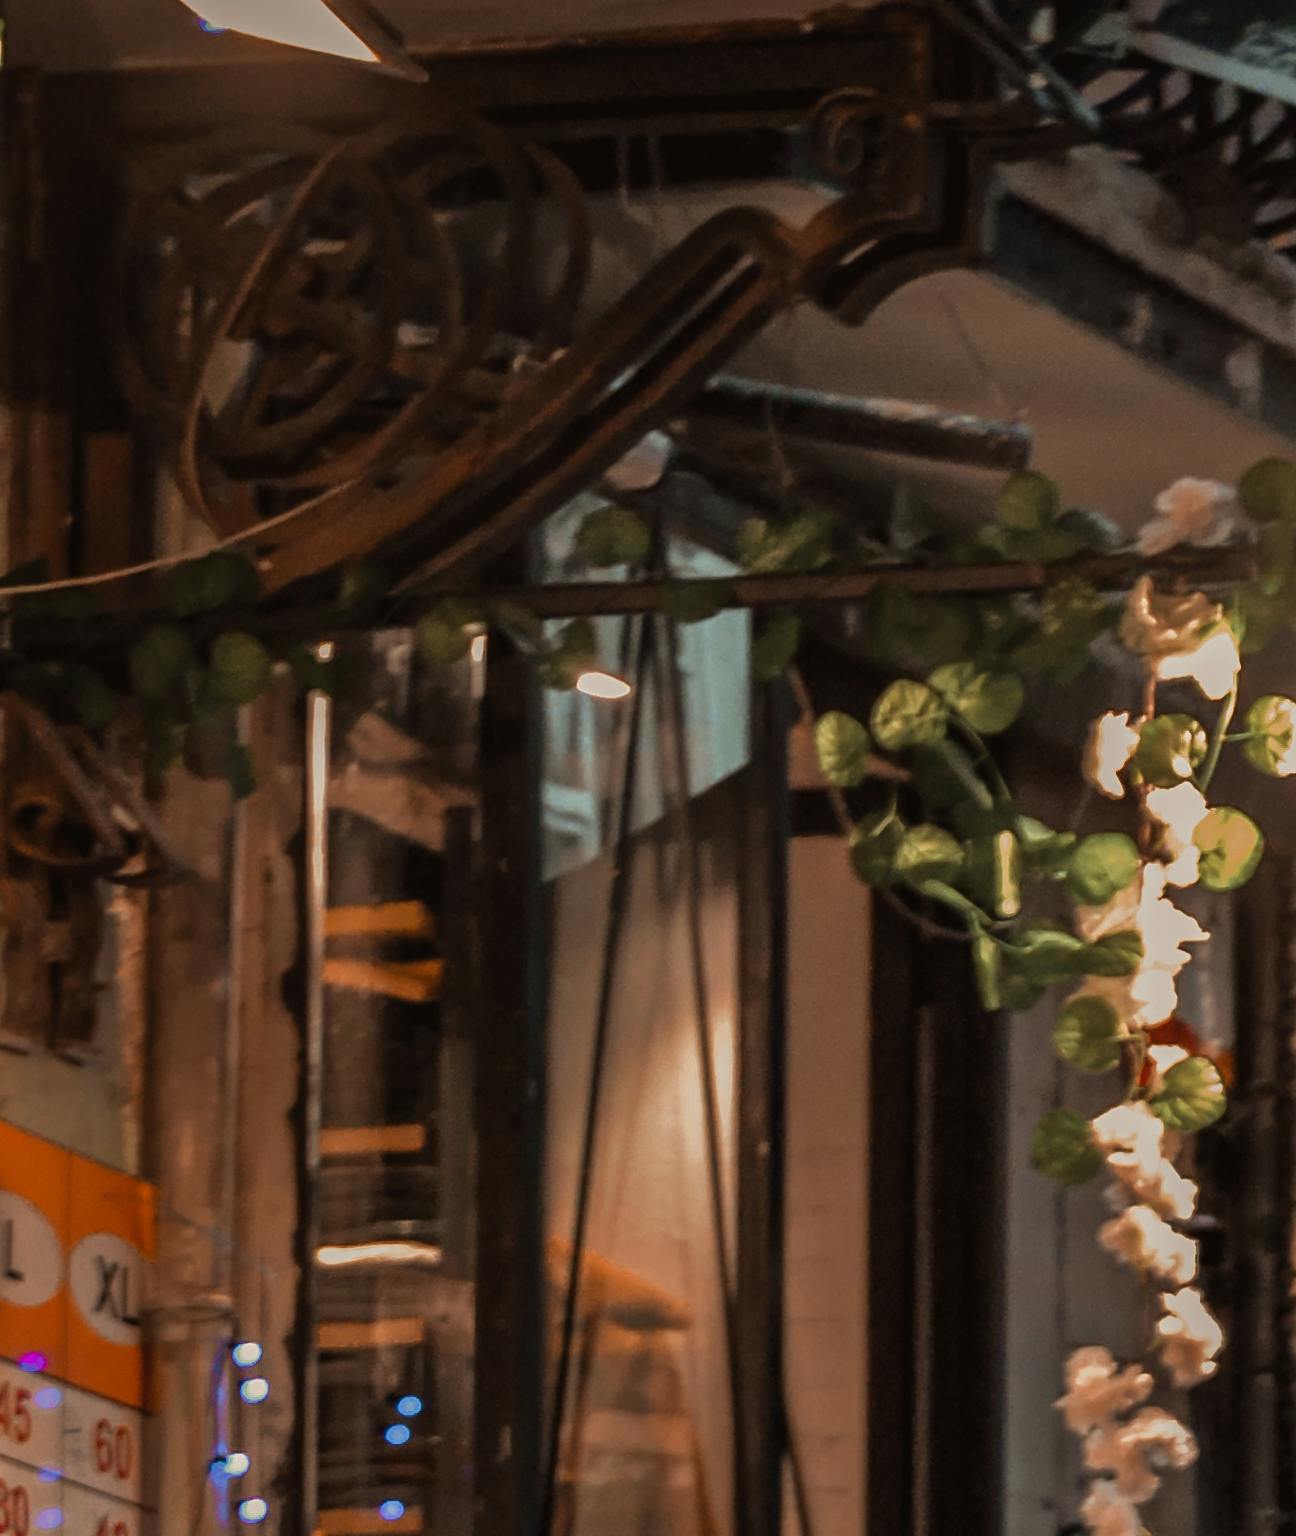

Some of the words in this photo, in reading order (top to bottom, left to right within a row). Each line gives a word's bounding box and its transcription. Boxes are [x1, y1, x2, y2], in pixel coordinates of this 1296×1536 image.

[4, 1219, 24, 1281] L
[94, 1254, 141, 1326] XL
[95, 1418, 131, 1480] 60
